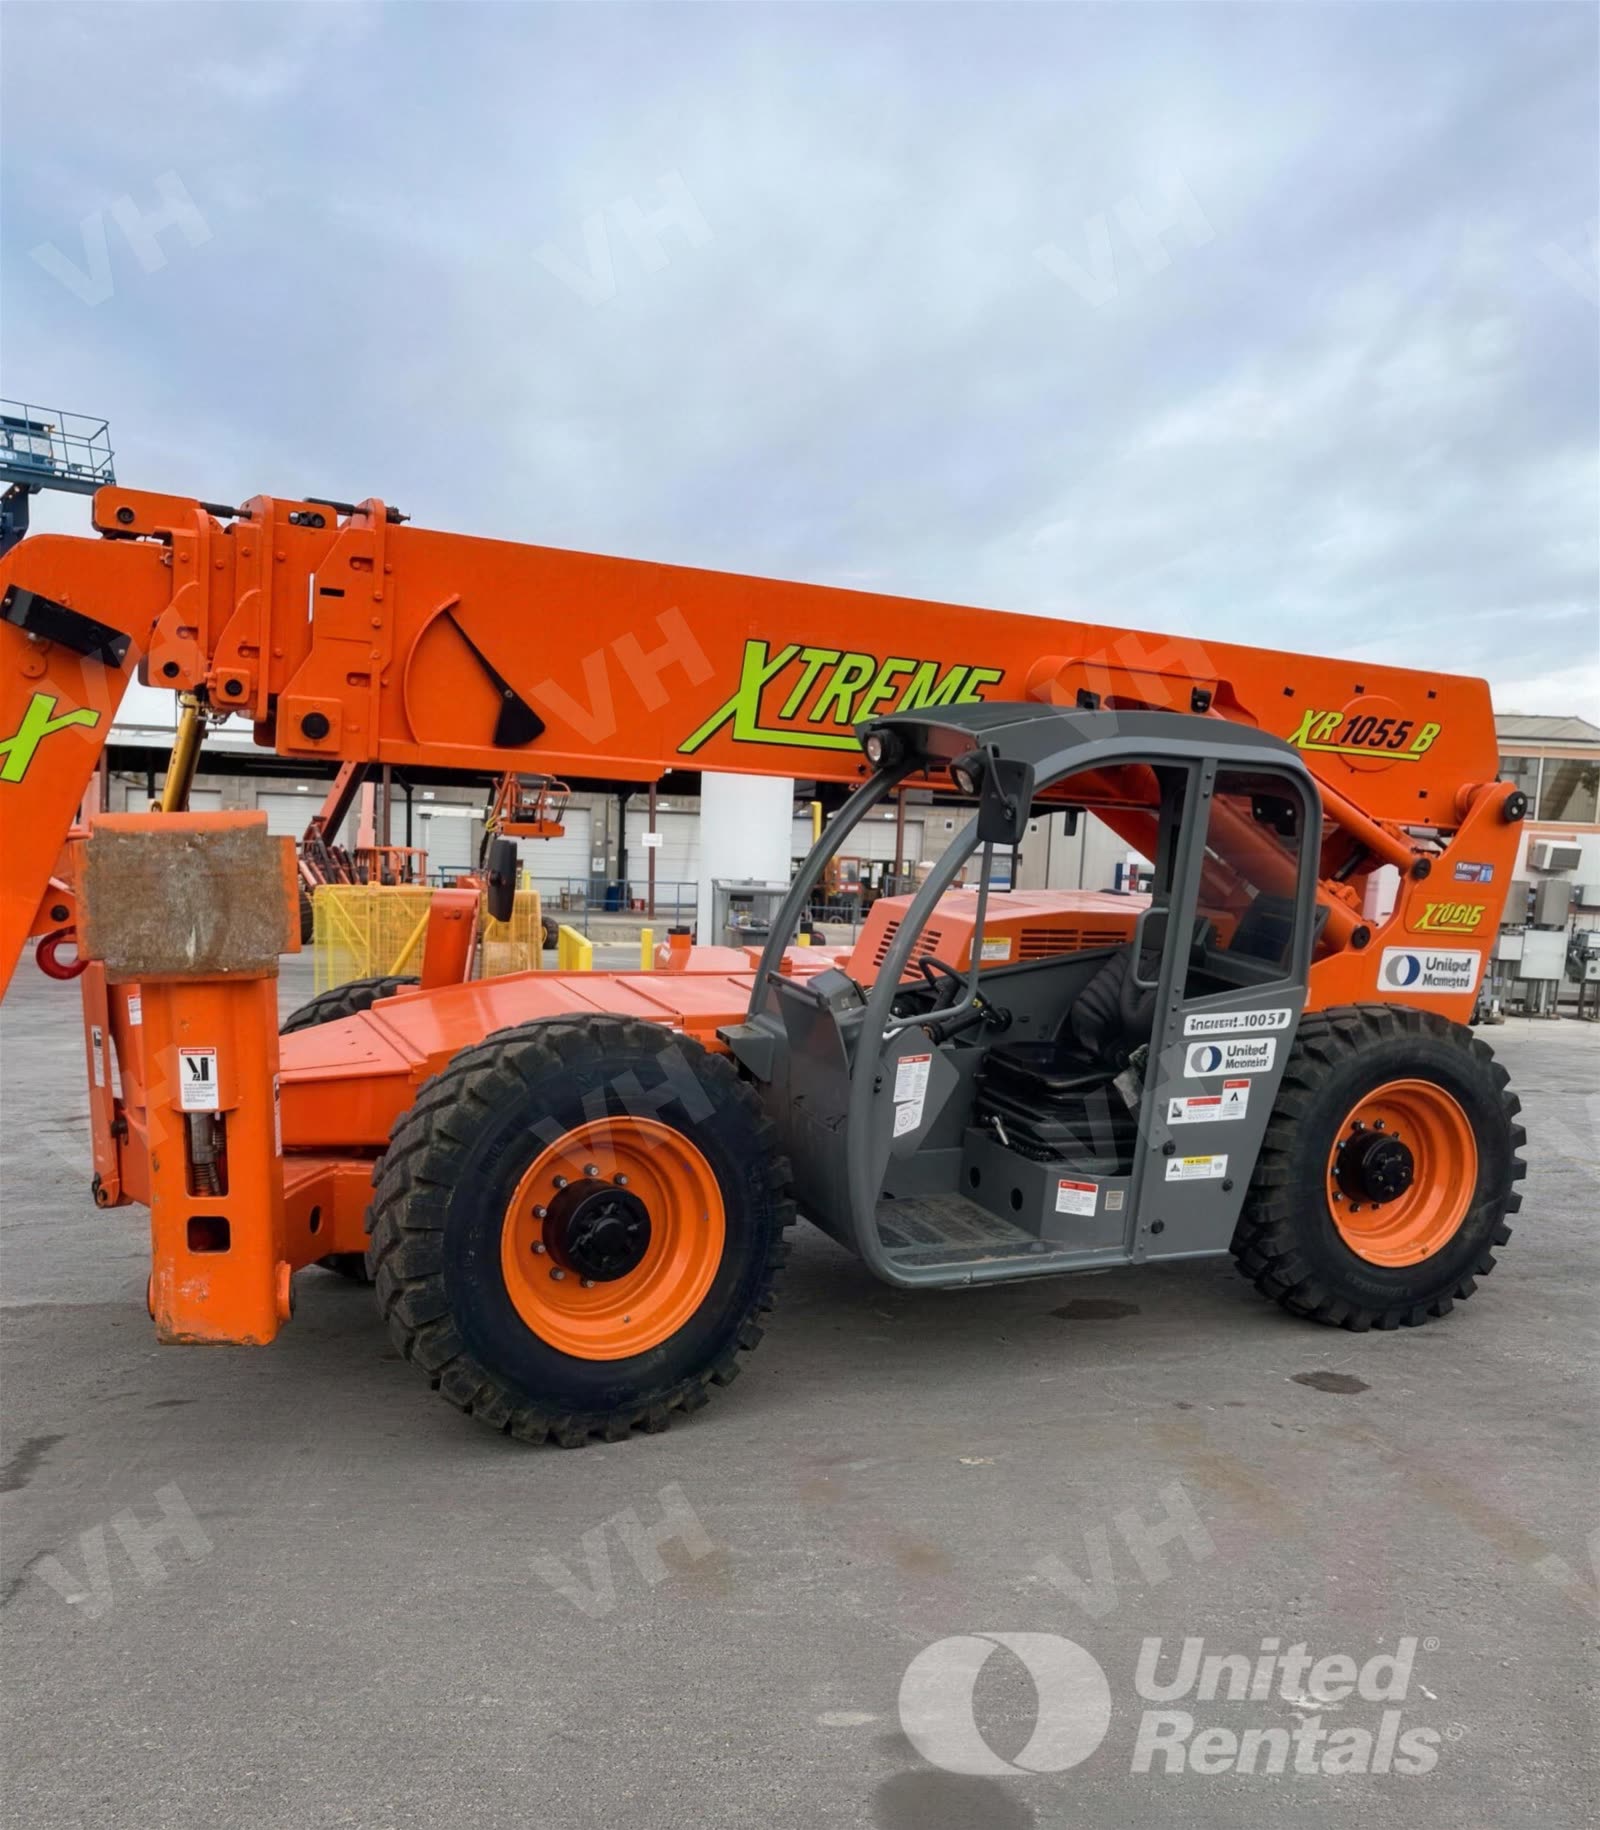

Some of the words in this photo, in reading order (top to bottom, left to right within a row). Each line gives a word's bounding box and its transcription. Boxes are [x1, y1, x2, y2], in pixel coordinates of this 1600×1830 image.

[1287, 709, 1345, 748] XR
[1341, 715, 1414, 749] 1055
[1409, 722, 1441, 753] B
